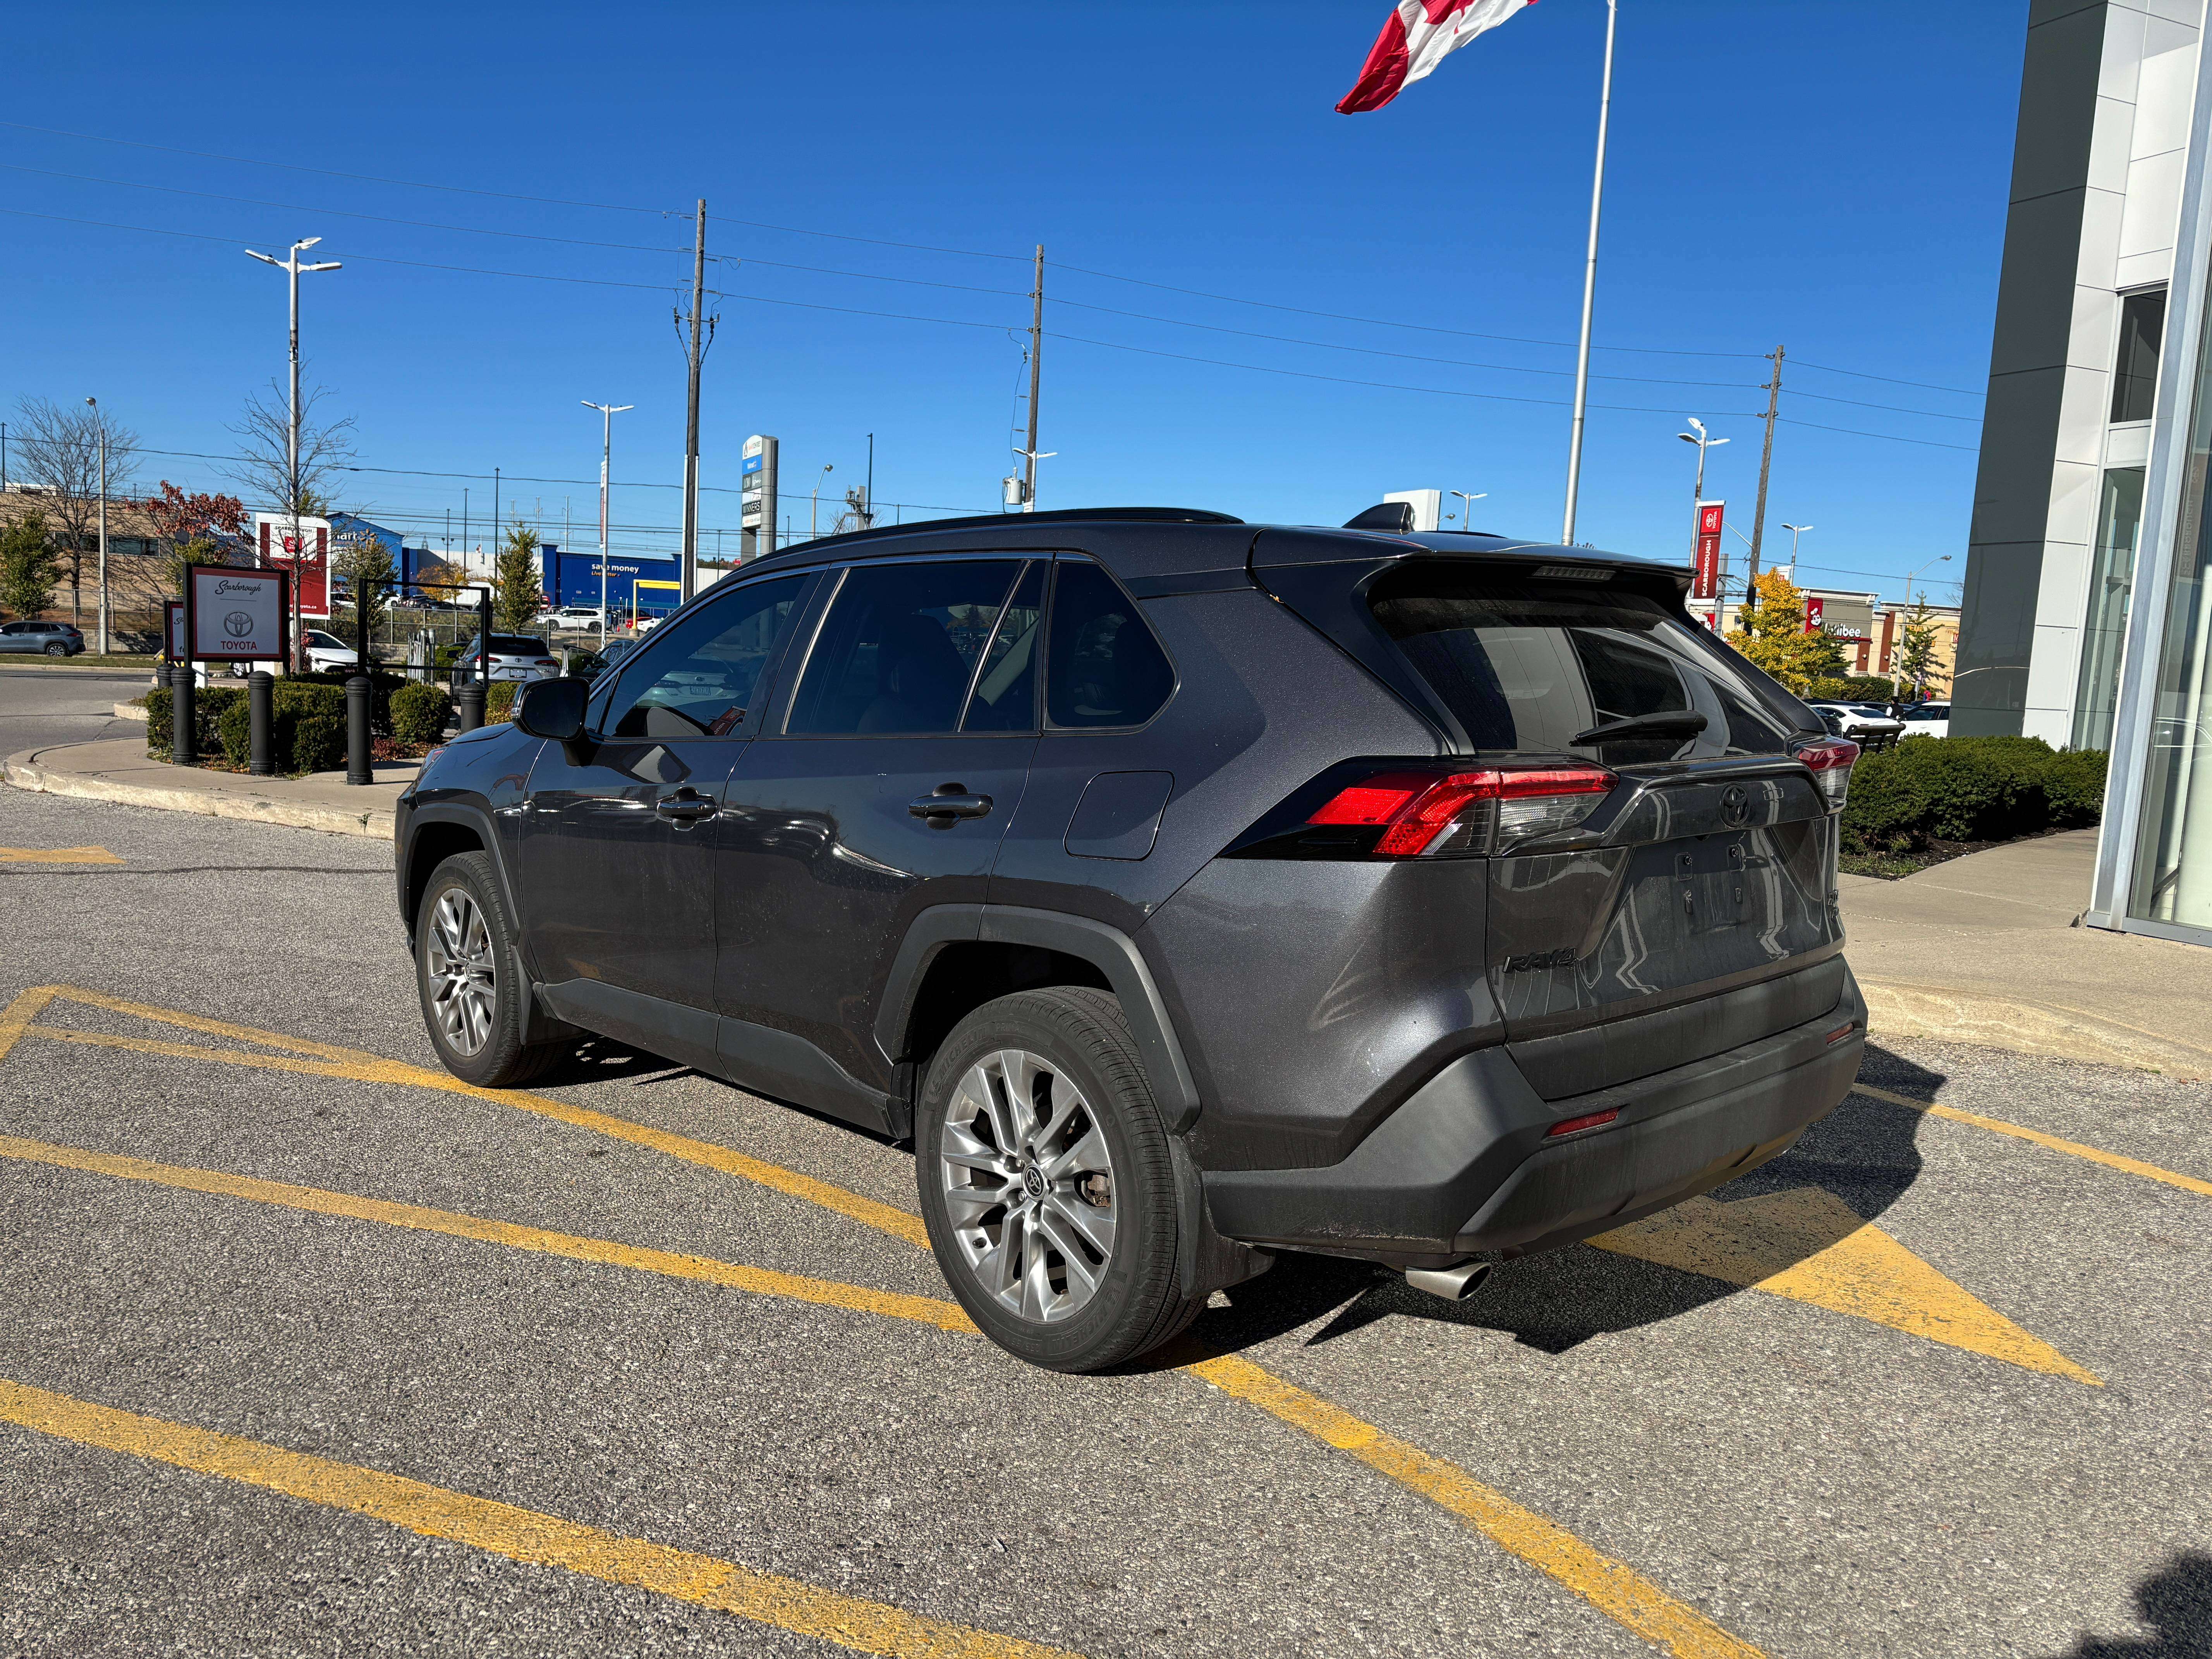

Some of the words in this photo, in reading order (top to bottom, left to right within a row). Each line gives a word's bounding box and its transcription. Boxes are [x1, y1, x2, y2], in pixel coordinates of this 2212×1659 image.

[611, 565, 639, 574] money
[1702, 540, 1712, 597] SCARBOROUGH
[215, 580, 261, 595] Scarborough
[220, 641, 257, 650] TOYOTA
